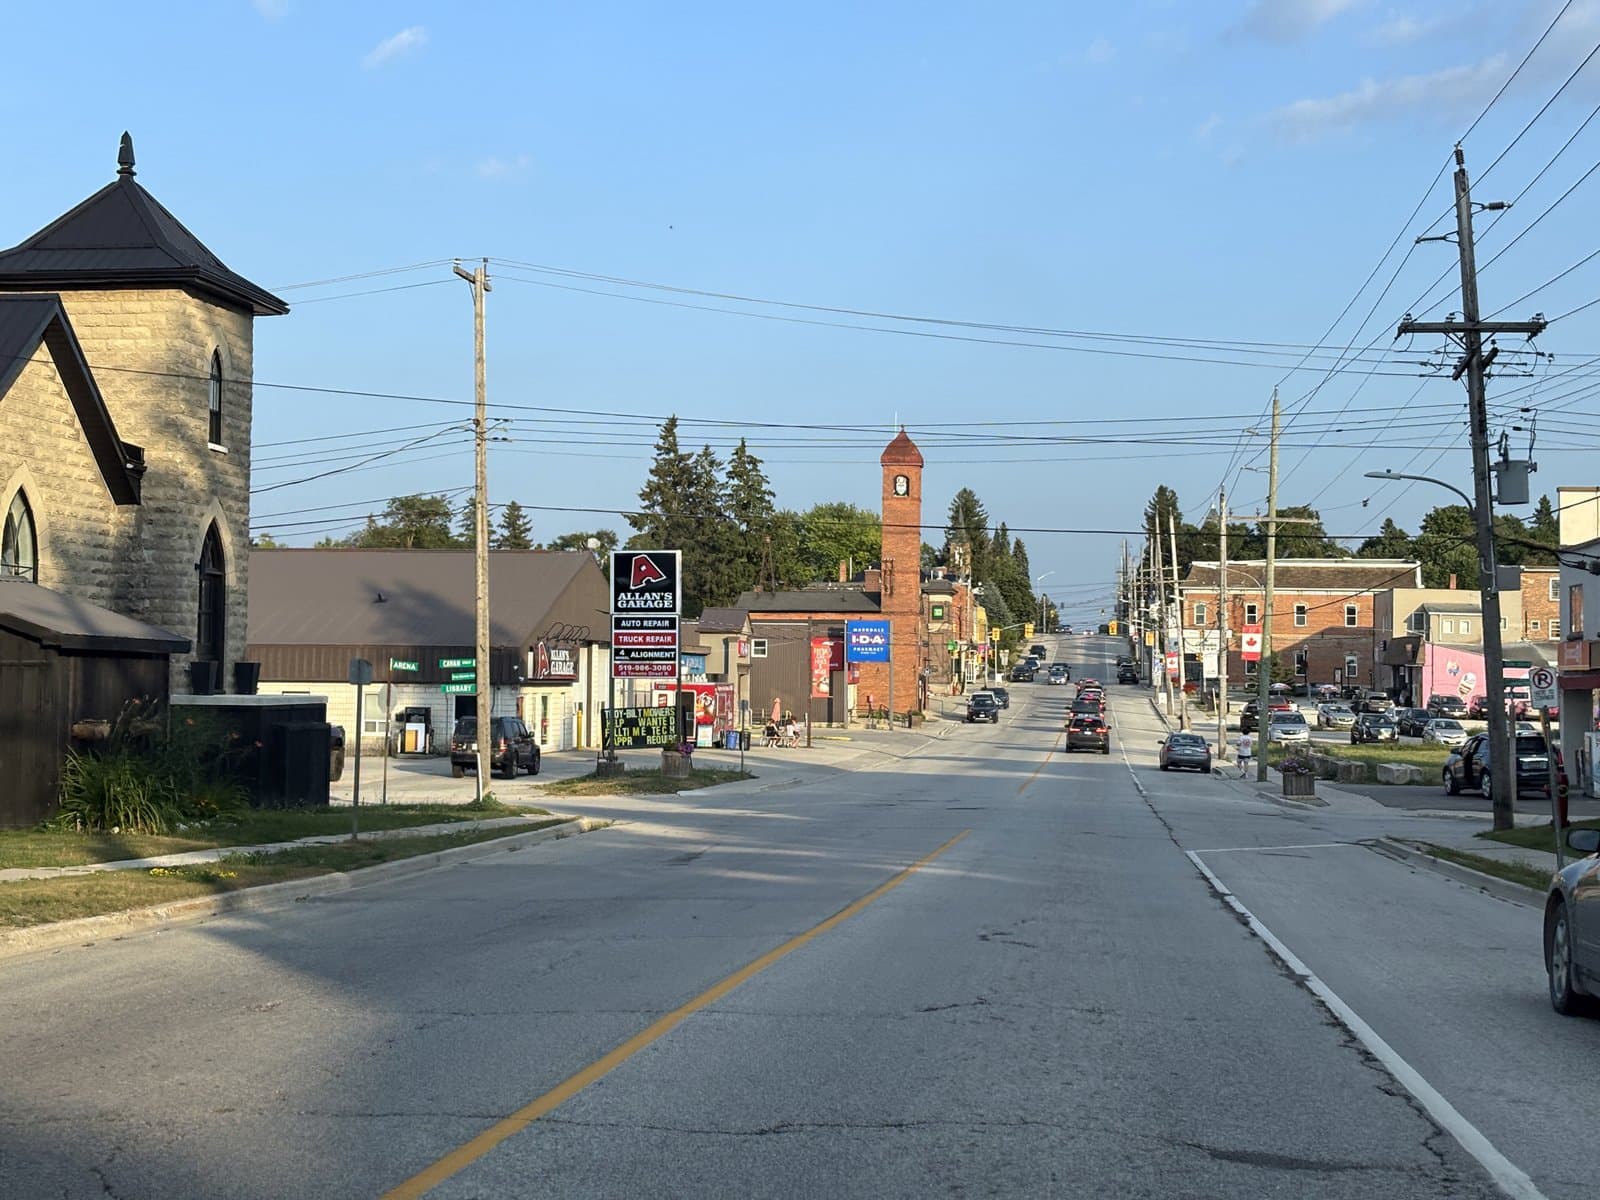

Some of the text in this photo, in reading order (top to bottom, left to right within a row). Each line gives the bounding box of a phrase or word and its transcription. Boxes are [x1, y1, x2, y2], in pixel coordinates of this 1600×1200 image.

[617, 592, 673, 600] ALLAN'S
[617, 600, 673, 608] GARAGE
[393, 660, 416, 670] ARENA
[446, 684, 472, 693] LIBRARY
[604, 709, 642, 719] TOY-BILT
[605, 716, 675, 729] HLP WANTED
[605, 725, 675, 737] FLLTIME TECH
